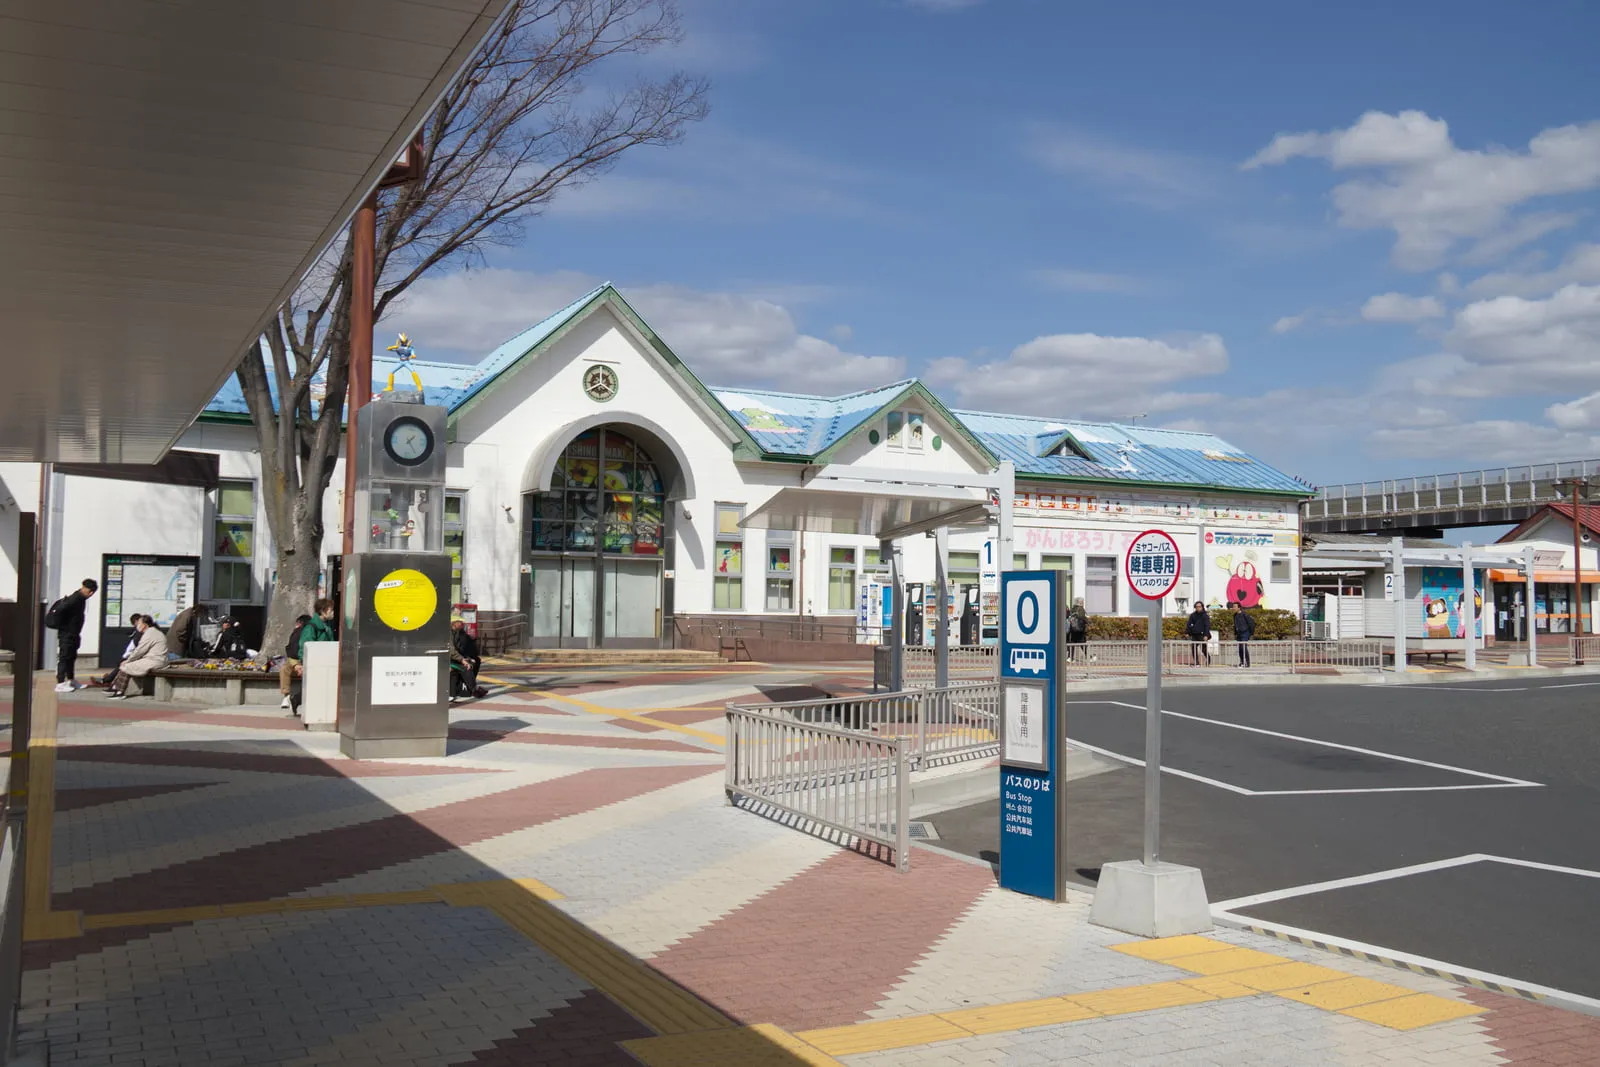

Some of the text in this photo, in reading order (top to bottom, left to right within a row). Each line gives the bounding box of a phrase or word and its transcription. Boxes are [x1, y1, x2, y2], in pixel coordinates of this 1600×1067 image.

[984, 540, 992, 565] 1
[1135, 542, 1171, 552] ミヤコーバス
[1130, 555, 1175, 574] 降車専用
[1135, 578, 1170, 587] バスのりば
[1386, 575, 1392, 588] 2
[1017, 590, 1040, 635] 0
[1005, 775, 1050, 792] バスのりば
[1005, 791, 1033, 804] Bus Stop
